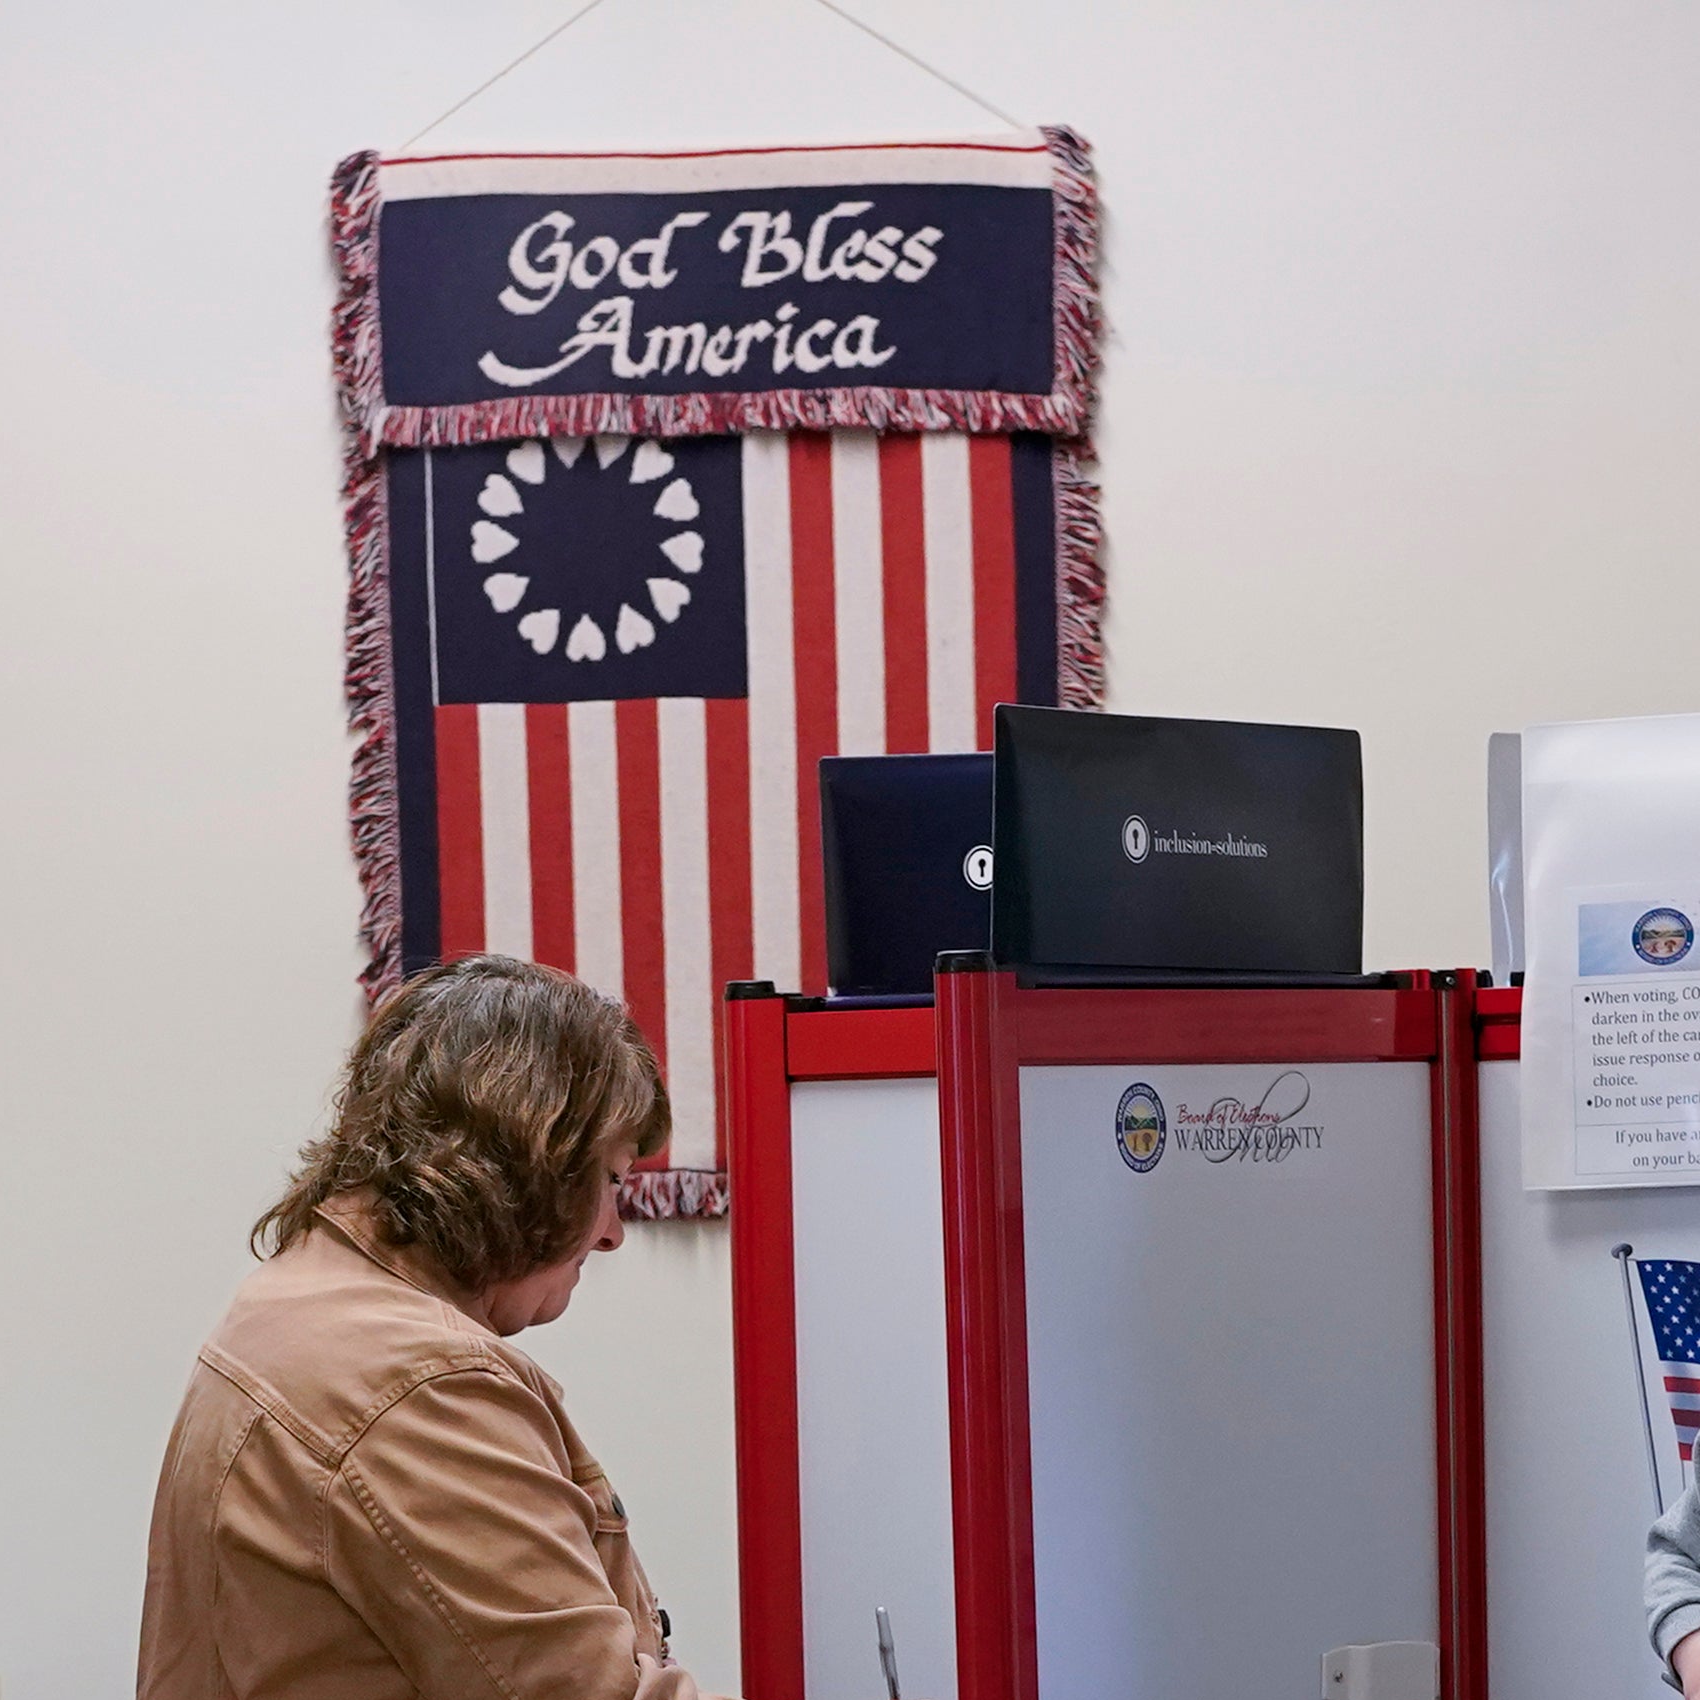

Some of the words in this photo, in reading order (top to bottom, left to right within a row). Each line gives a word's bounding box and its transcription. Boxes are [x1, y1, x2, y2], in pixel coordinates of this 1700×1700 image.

[498, 210, 710, 315] God
[718, 201, 944, 288] Bless
[478, 296, 897, 388] America
[1590, 990, 1630, 1005] When
[1591, 1011, 1639, 1026] darken
[1642, 1008, 1654, 1023] in
[1658, 1008, 1680, 1023] the
[1591, 1032, 1614, 1047] the
[1616, 1030, 1638, 1046] left
[1641, 1029, 1656, 1045] of
[1658, 1028, 1680, 1044] the
[1592, 1053, 1627, 1068] issue
[1629, 1052, 1691, 1068] response
[1593, 1072, 1639, 1088] choice.
[1594, 1094, 1613, 1109] Do
[1615, 1094, 1637, 1109] not
[1640, 1095, 1663, 1107] use
[1176, 1103, 1214, 1124] Board
[1174, 1127, 1251, 1151] WARREN
[1253, 1126, 1324, 1150] COUNTY
[1615, 1129, 1627, 1144] If
[1628, 1132, 1652, 1147] you
[1656, 1129, 1688, 1143] have
[1632, 1154, 1650, 1167] on
[1652, 1153, 1685, 1169] your
